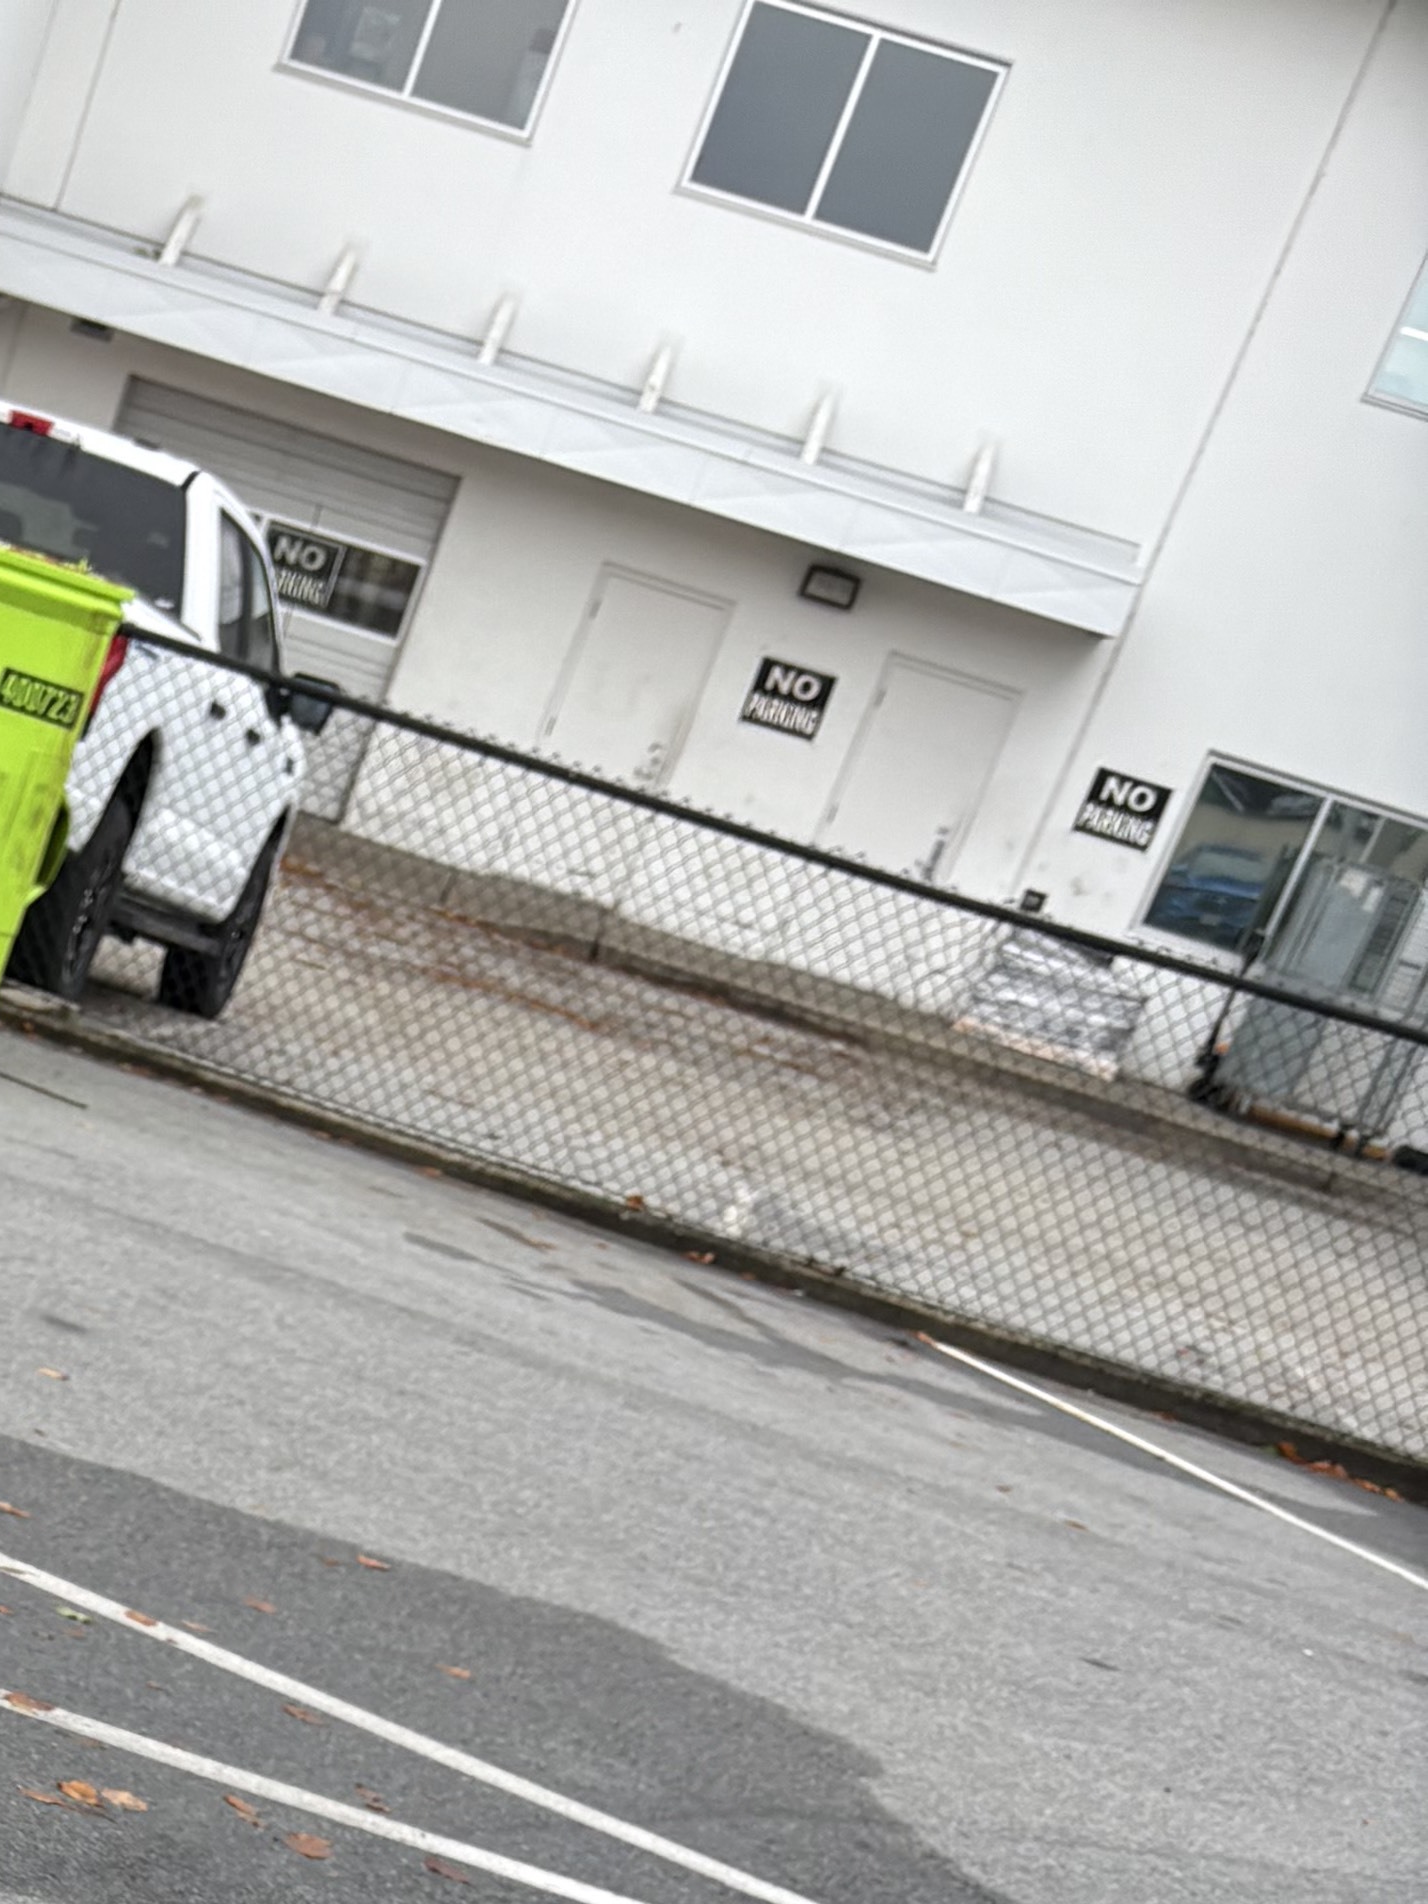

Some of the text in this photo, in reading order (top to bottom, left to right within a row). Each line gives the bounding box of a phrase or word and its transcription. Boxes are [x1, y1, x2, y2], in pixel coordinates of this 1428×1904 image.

[273, 536, 325, 571] NO
[764, 665, 823, 701] NO
[745, 694, 819, 735] PARKING
[1099, 777, 1157, 812] NO
[1078, 803, 1153, 846] PARKING
